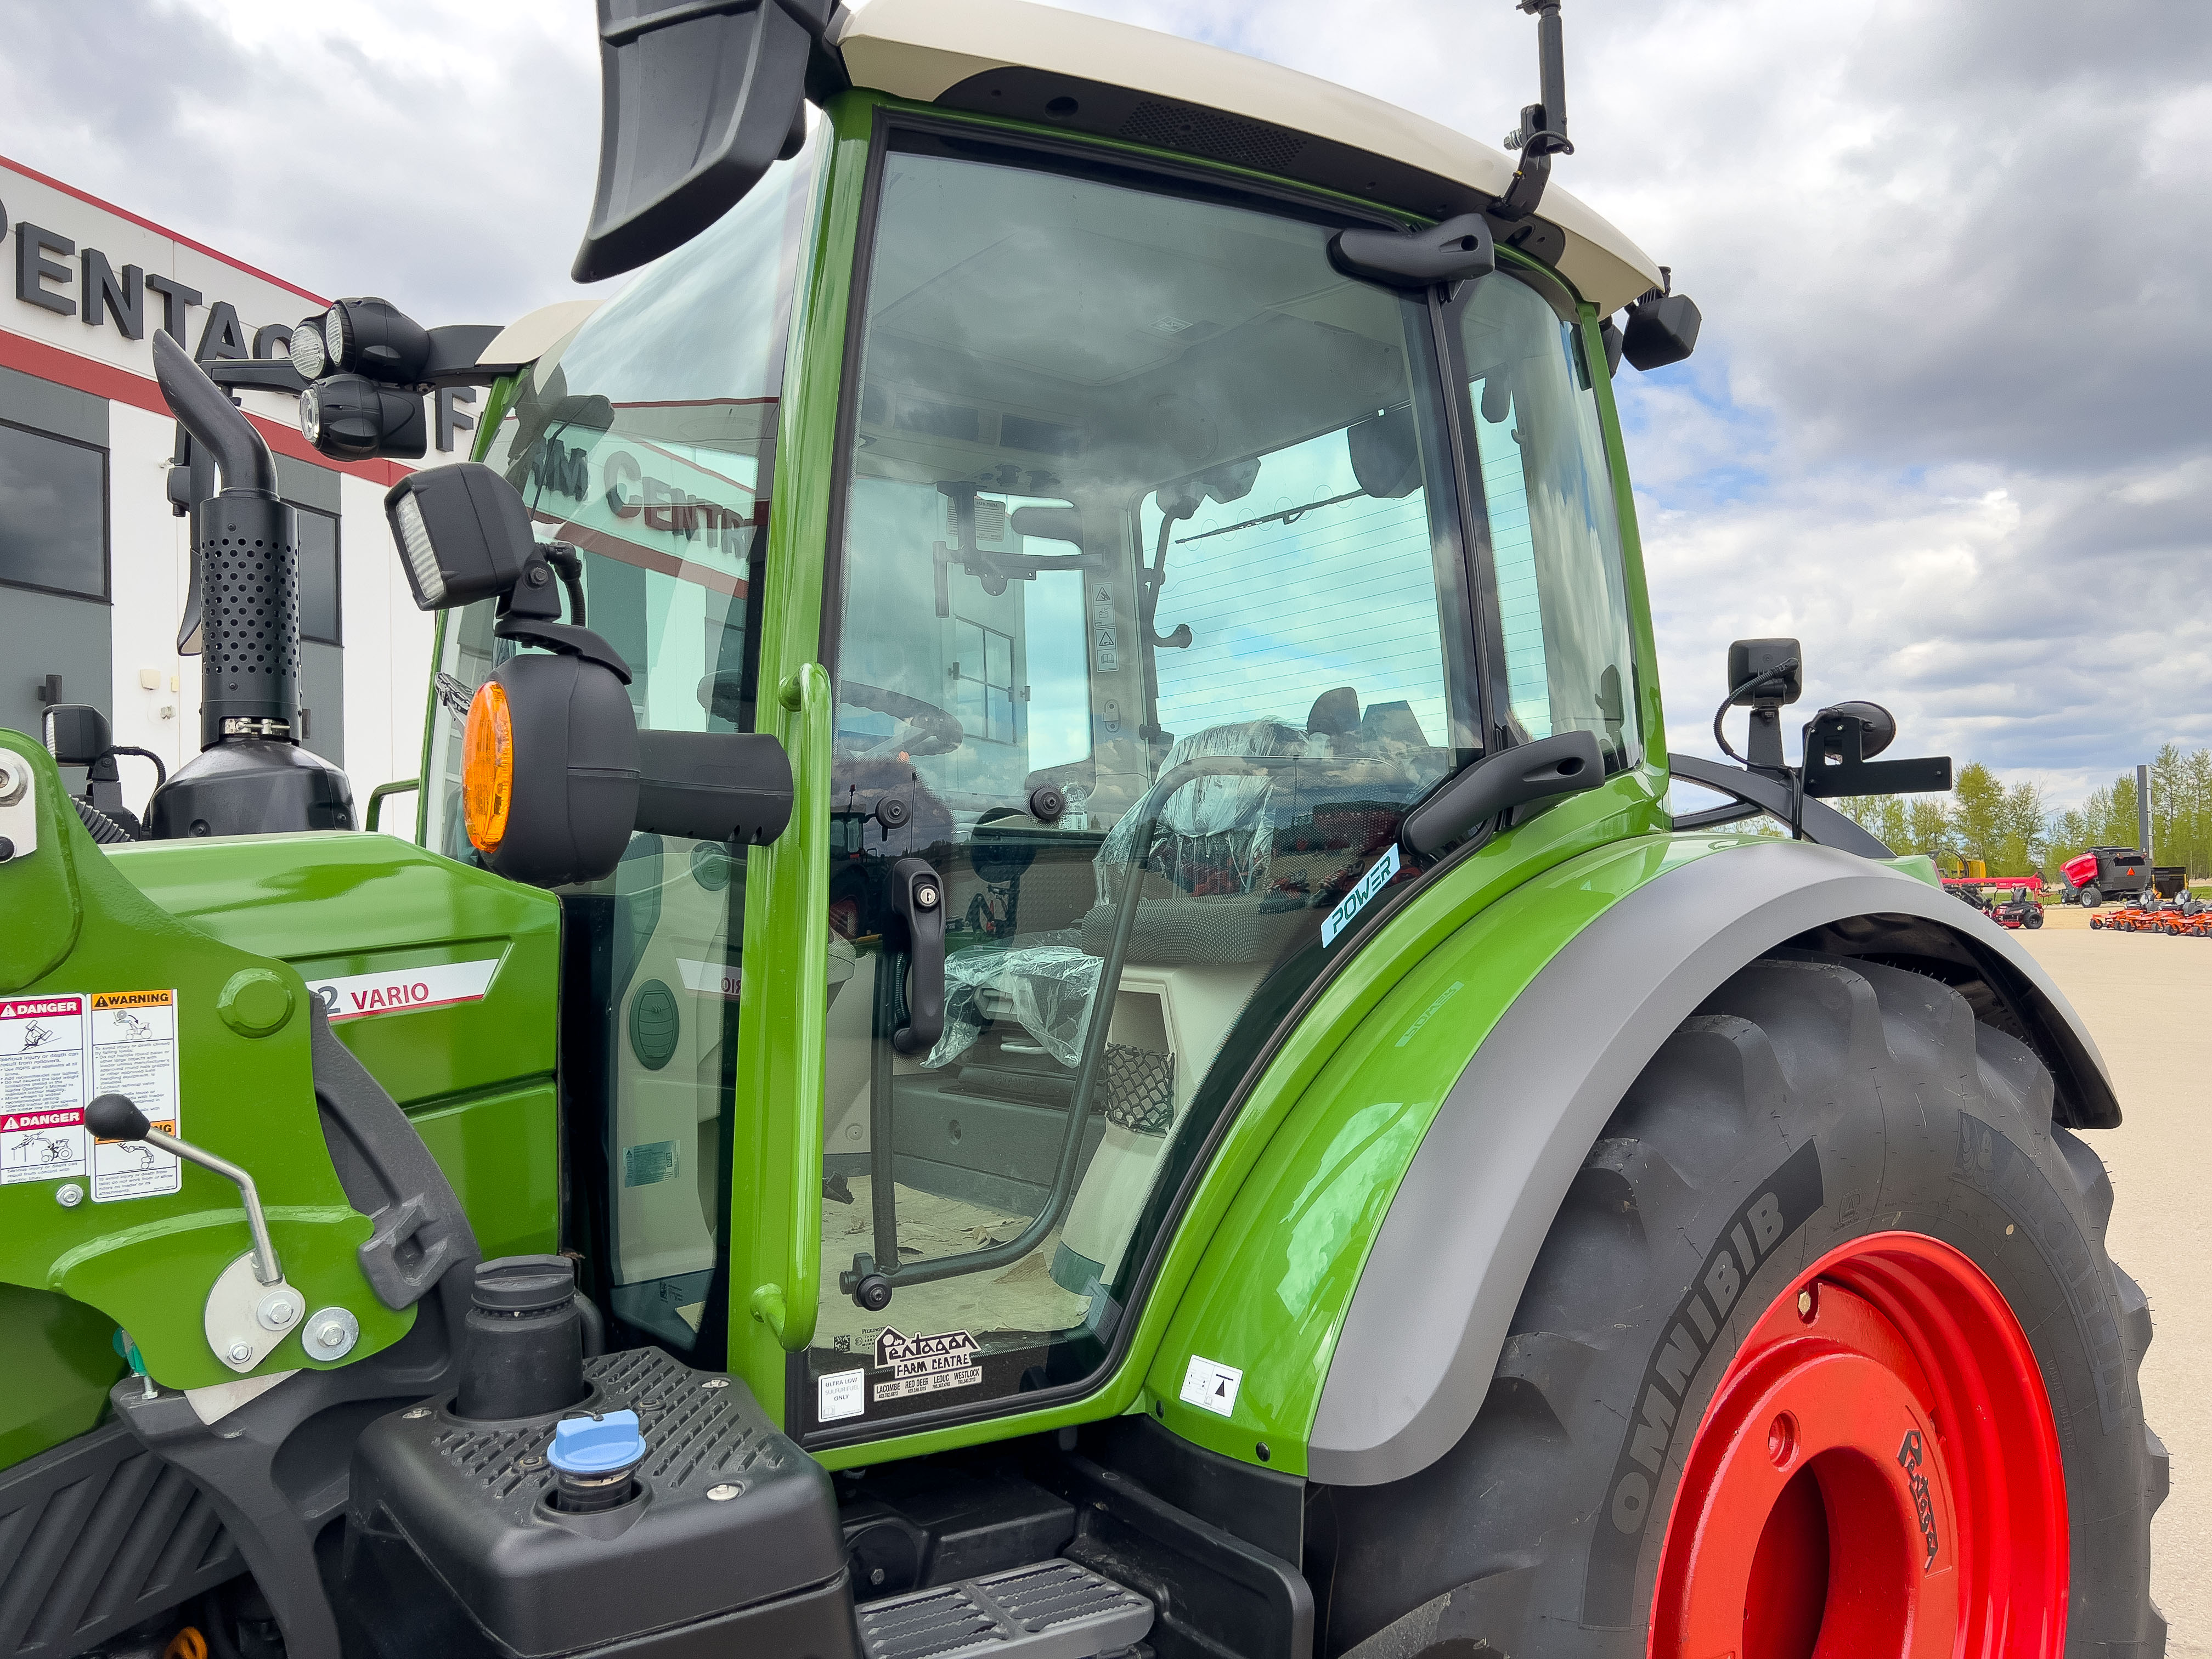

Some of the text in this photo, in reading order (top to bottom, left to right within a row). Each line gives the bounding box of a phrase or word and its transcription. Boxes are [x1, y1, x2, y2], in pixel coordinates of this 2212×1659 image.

[0, 199, 292, 362] ENTA
[1332, 856, 1391, 935] POWER
[17, 1001, 77, 1015] DANGER
[108, 993, 169, 1006] WARNING
[351, 983, 429, 1010] VARIO
[20, 1112, 80, 1127] DANGER
[877, 1328, 978, 1365] Pentagon
[897, 1353, 969, 1376] FARM CENTRE
[1611, 1193, 1784, 1534] OMNIBIB
[825, 1387, 845, 1396] SULFUR
[876, 1382, 900, 1393] LACOMBE
[916, 1378, 929, 1386] DEER
[934, 1374, 949, 1384] LEDUC
[954, 1368, 980, 1380] WESTLOCK
